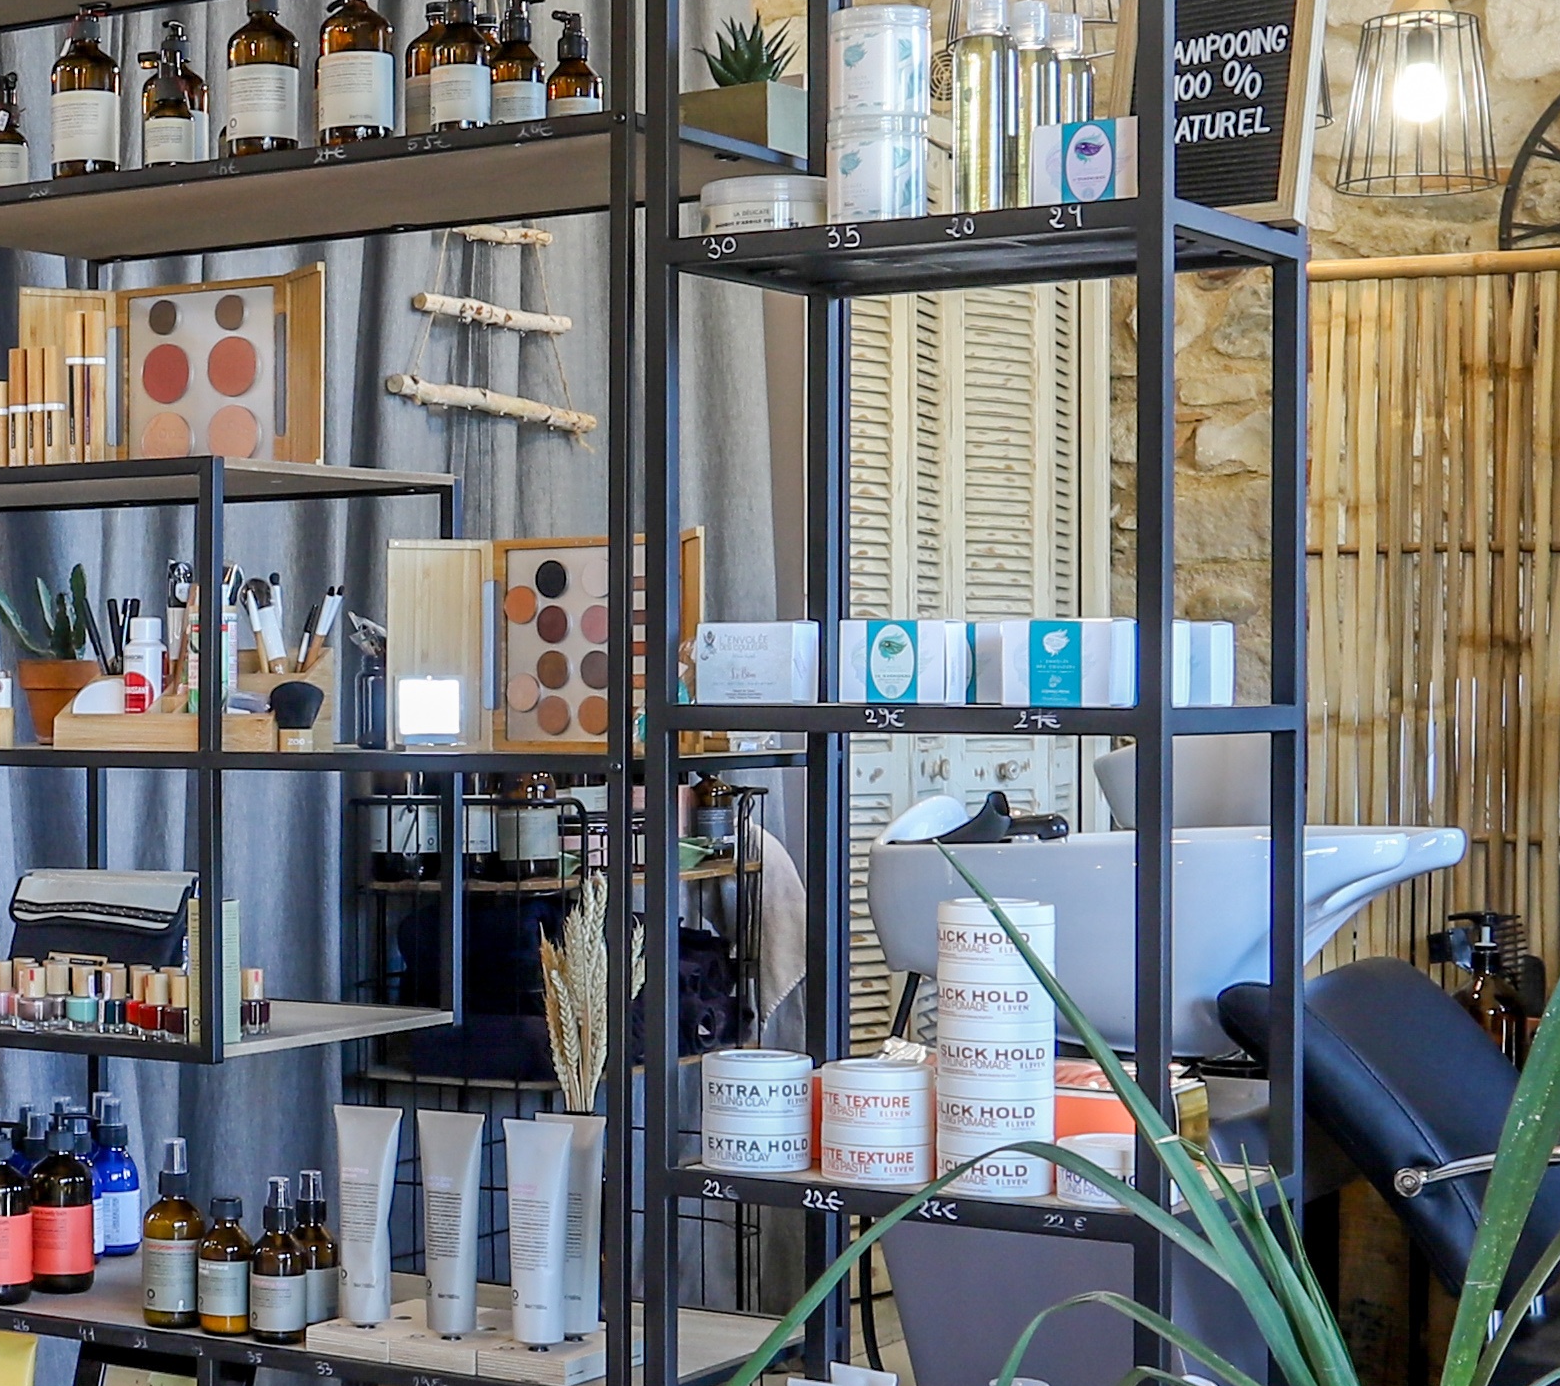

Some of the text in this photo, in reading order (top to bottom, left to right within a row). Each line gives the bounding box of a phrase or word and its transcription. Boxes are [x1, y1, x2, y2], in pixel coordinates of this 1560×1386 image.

[1174, 25, 1288, 65] AMPOOING
[1222, 60, 1262, 99] %
[1174, 106, 1271, 144] ATUREL
[946, 218, 976, 238] 20
[827, 225, 860, 249] 35
[702, 236, 738, 260] 30
[938, 930, 1029, 944] LICK HOLD
[952, 944, 990, 954] POMADE
[938, 987, 1028, 1003] LICK HOLD
[952, 1002, 989, 1011] POMADE
[941, 1044, 1045, 1060] SLICK HOLD
[969, 1060, 1012, 1070] POMADE
[709, 1082, 808, 1097] EXTRA HOLD
[745, 1097, 770, 1108] CLAY
[845, 1094, 910, 1108] TEXTURE
[839, 1106, 867, 1118] PASTE
[981, 1106, 1035, 1119] HOLD
[709, 1137, 808, 1152] EXTRA HOLD
[745, 1151, 770, 1162] CLAY
[849, 1151, 914, 1164] TEXTURE
[843, 1162, 870, 1174] PASTE
[972, 1164, 1028, 1177] HOLD
[803, 1189, 844, 1211] 22€
